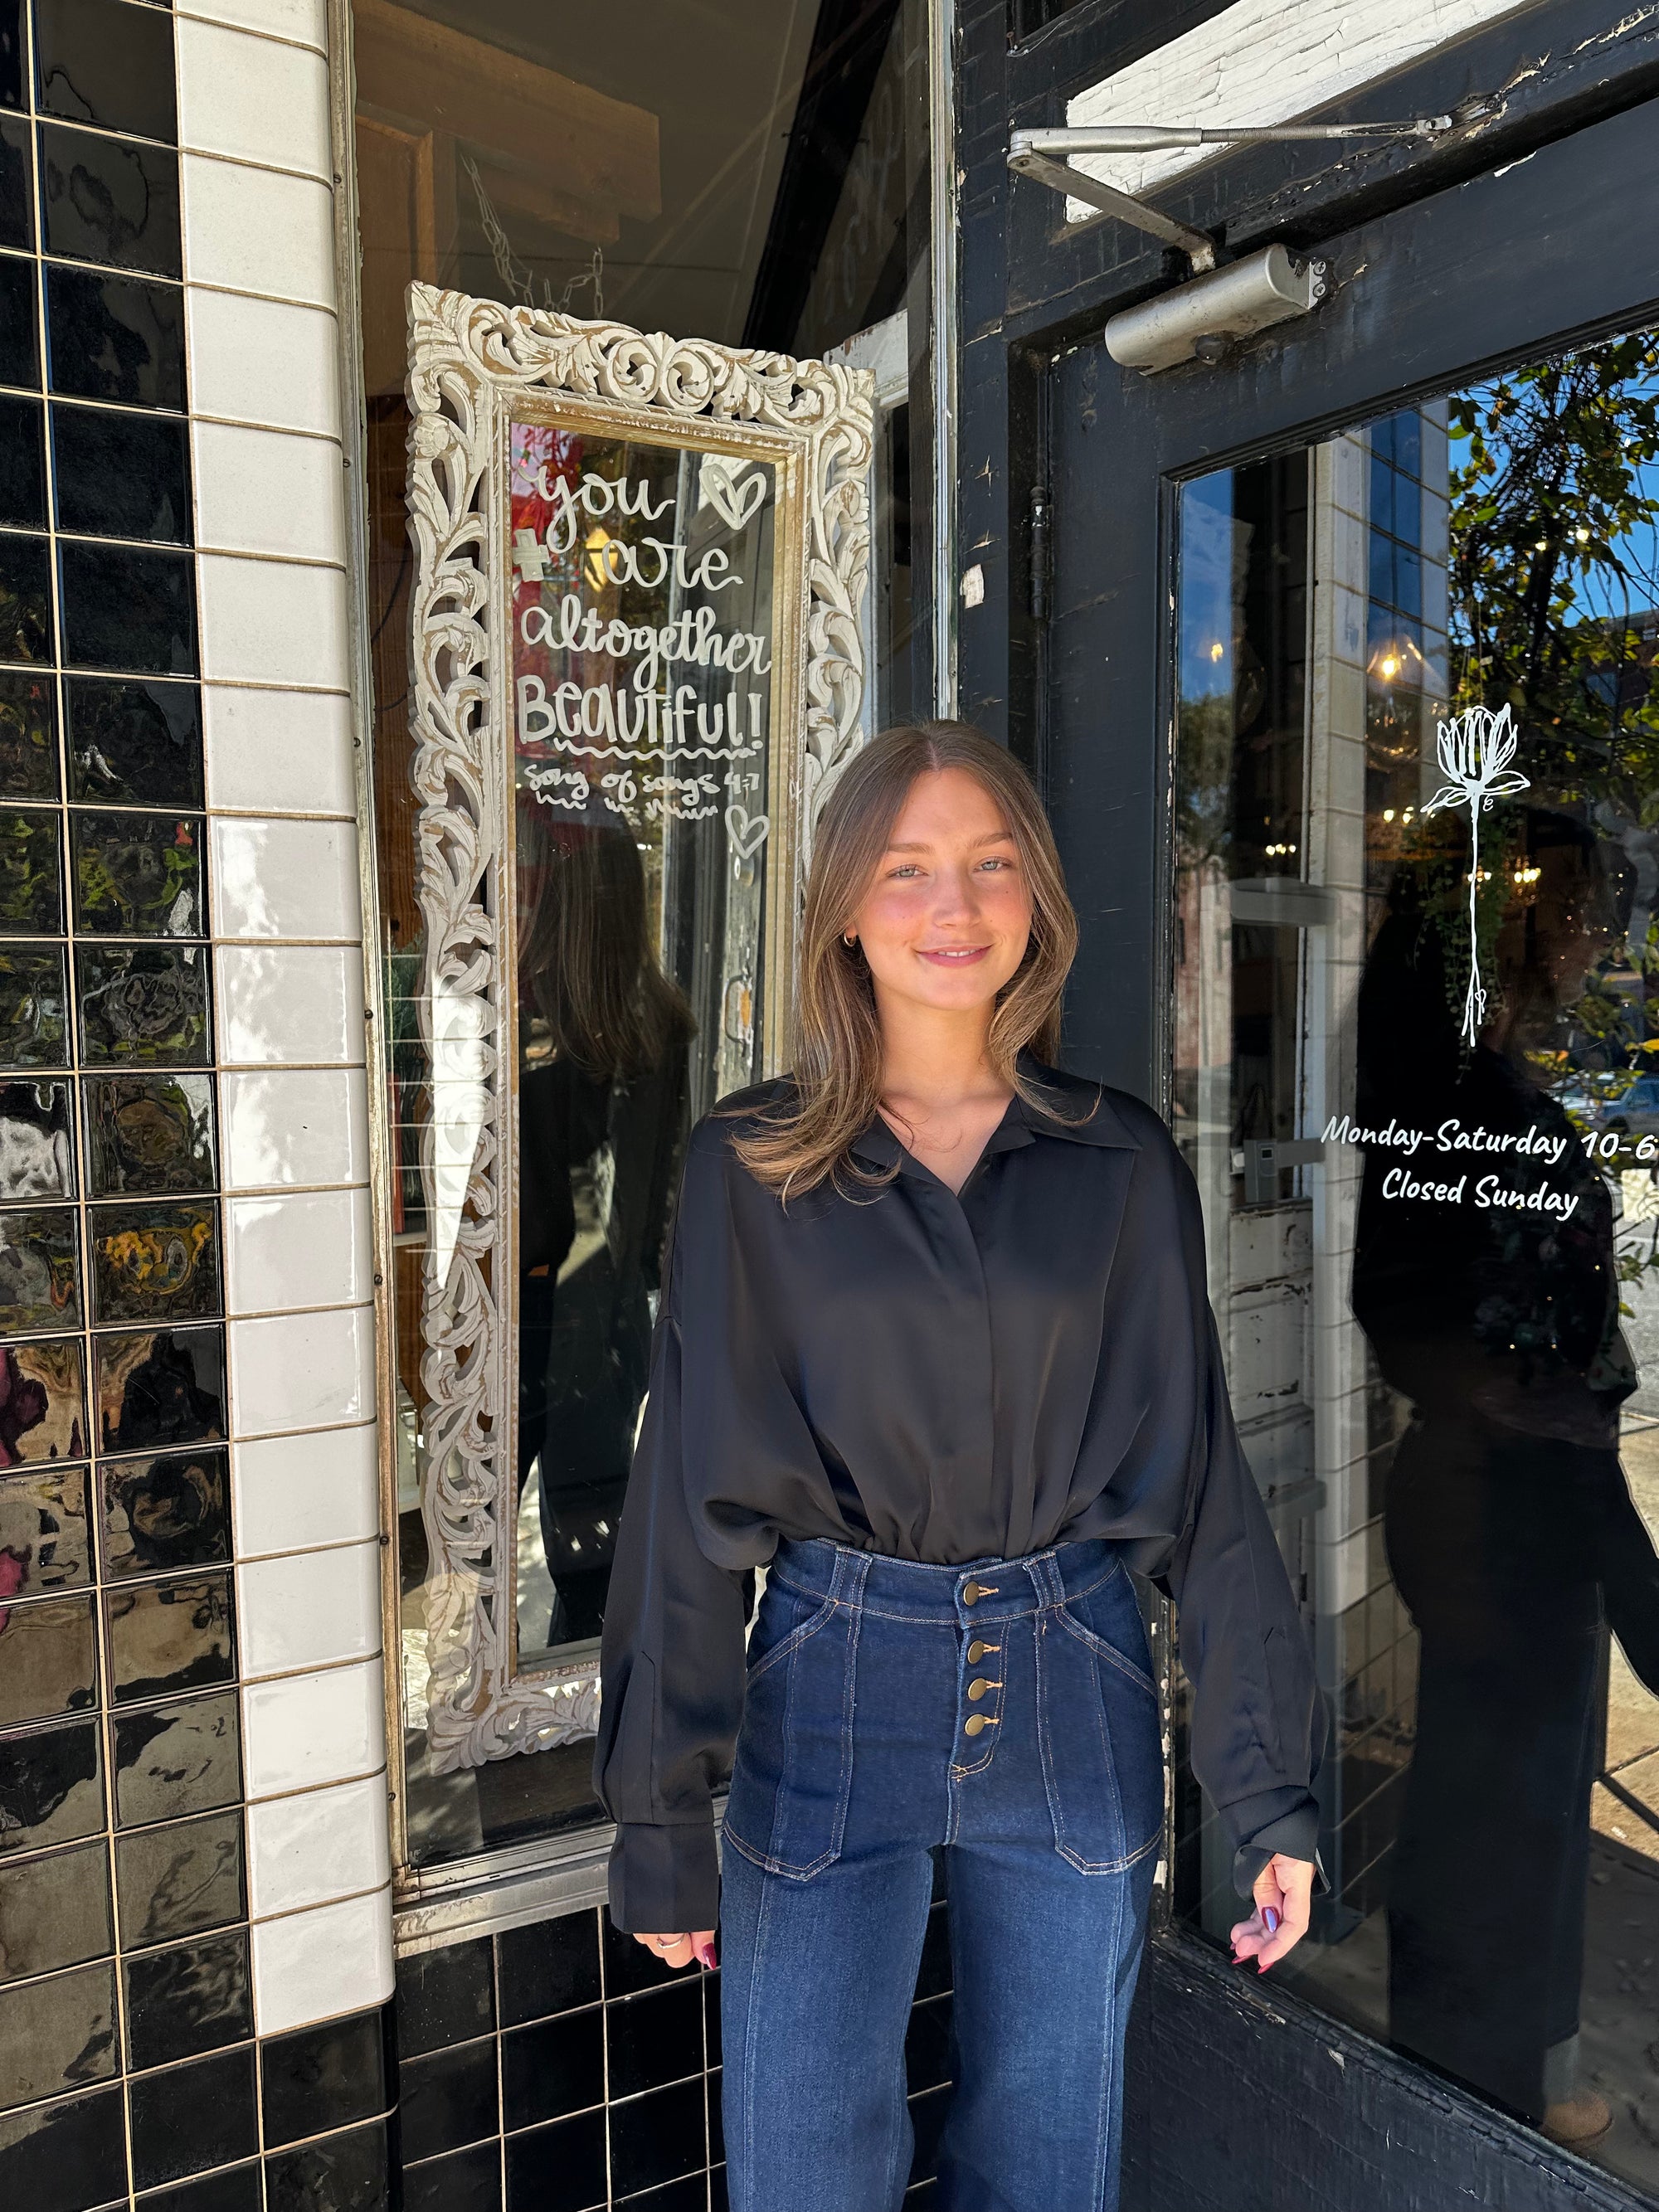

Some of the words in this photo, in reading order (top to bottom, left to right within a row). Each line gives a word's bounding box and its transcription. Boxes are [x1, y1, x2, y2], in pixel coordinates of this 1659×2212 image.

[518, 466, 676, 553] you
[601, 537, 743, 591] are
[520, 594, 771, 693] altogether
[601, 770, 637, 803] of
[642, 773, 721, 806] songs
[1321, 1115, 1568, 1164] Monday-Saturday
[1580, 1130, 1657, 1160] 10-6
[1382, 1168, 1467, 1203] Closed
[1474, 1174, 1579, 1222] Sunday
